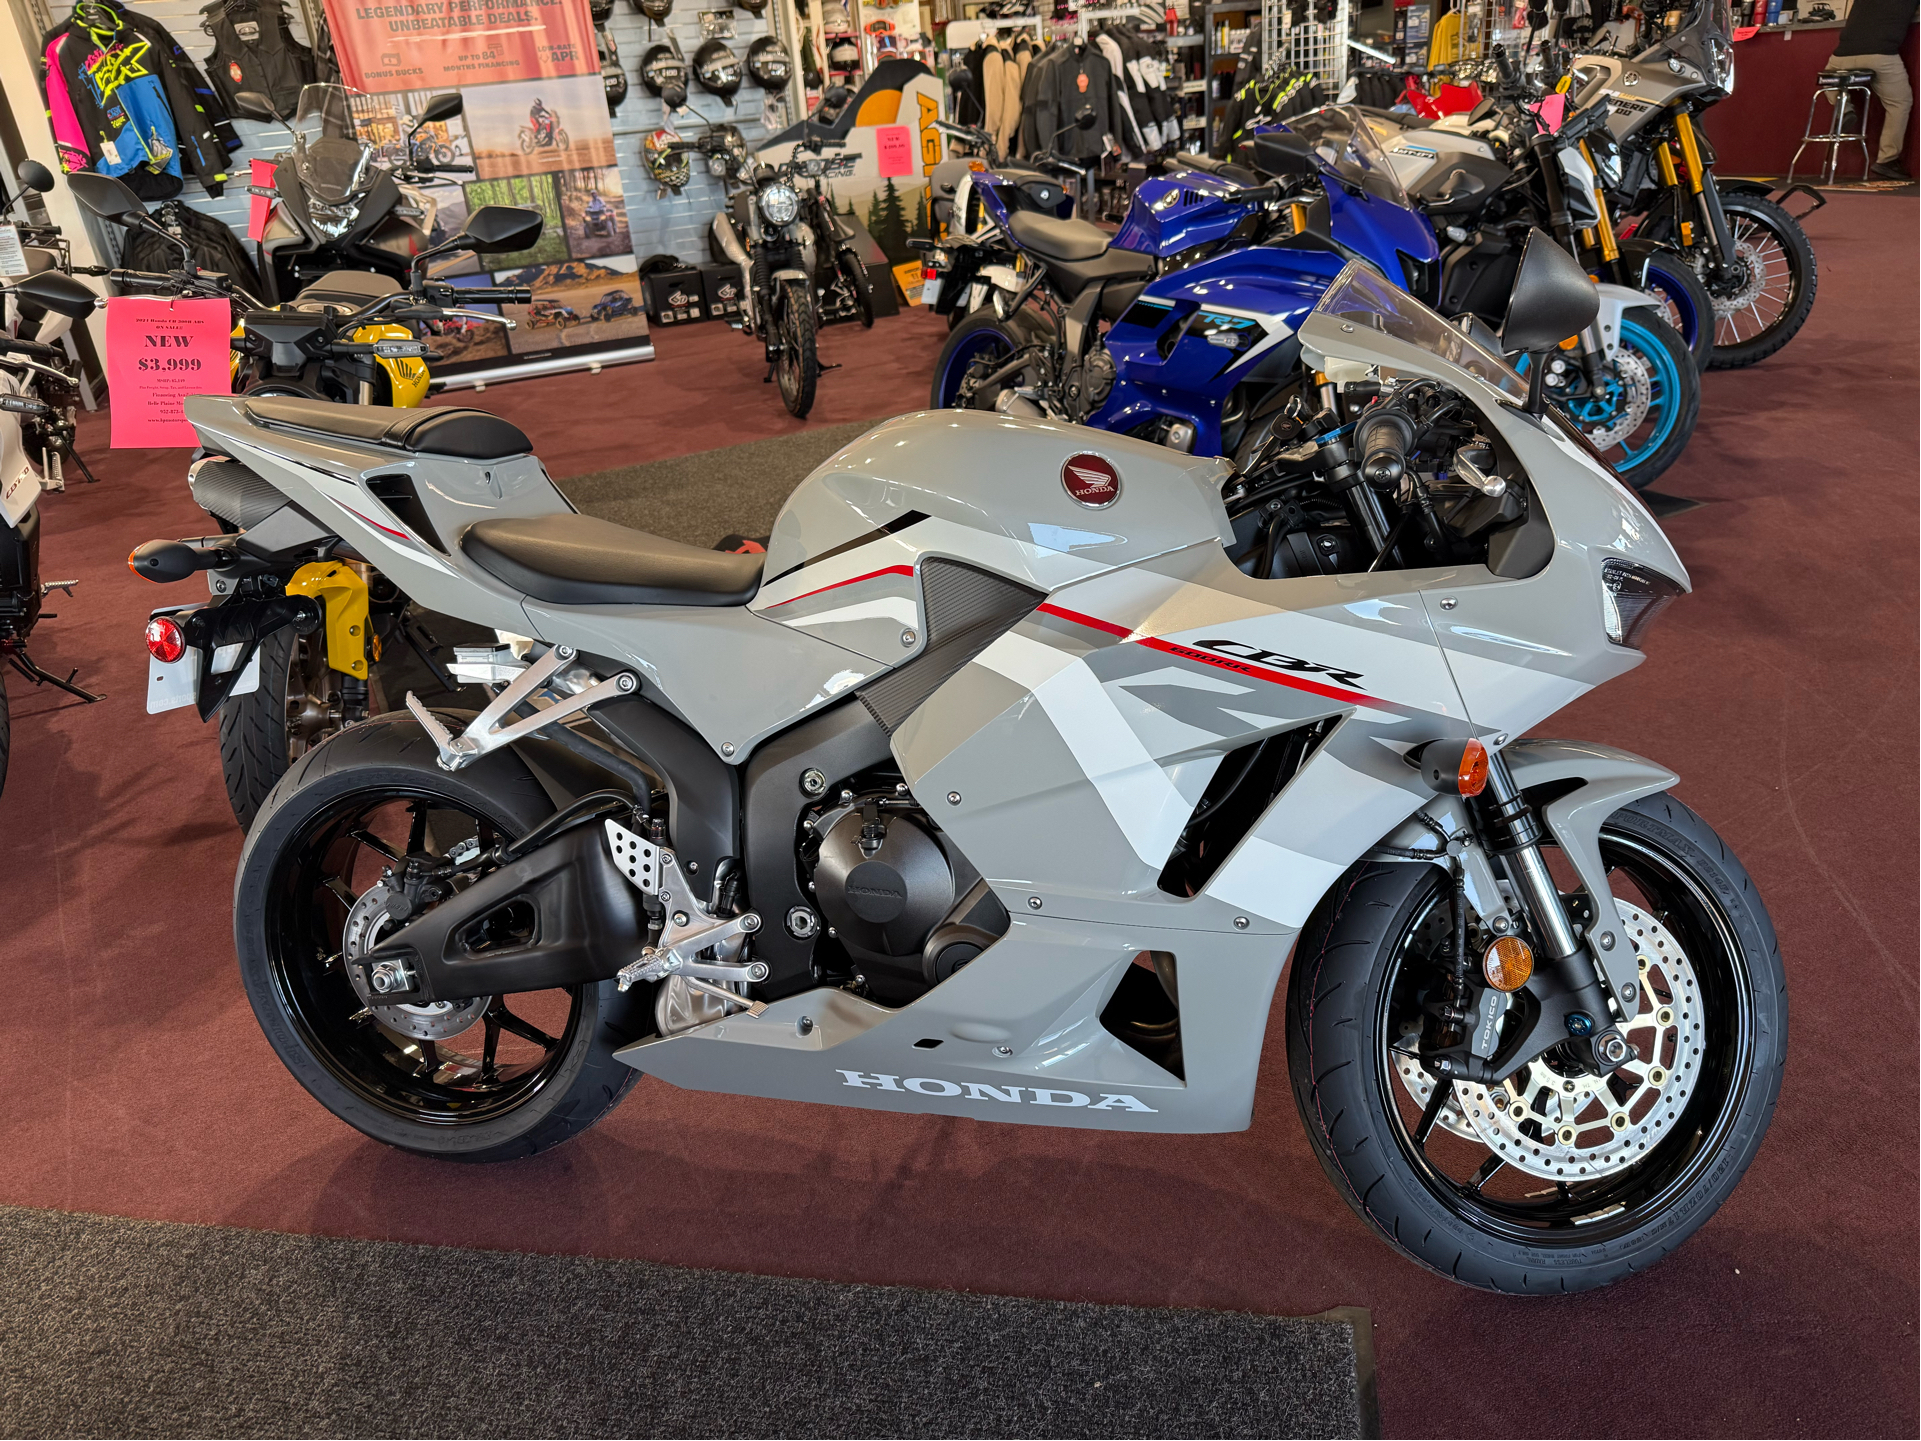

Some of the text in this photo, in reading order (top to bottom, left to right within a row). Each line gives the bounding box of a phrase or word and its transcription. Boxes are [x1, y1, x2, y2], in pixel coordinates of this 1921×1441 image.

[355, 0, 562, 20] LEGENDARY PERFORMANCE.
[388, 10, 539, 32] UNBEATABLE DEALS.
[537, 43, 577, 53] LOW-RATE
[458, 50, 496, 62] UP TO 84
[550, 50, 579, 63] APR
[364, 67, 424, 79] BONUS BUCKS
[443, 60, 520, 72] MONTHS FINANCING
[144, 335, 194, 348] NEW
[138, 357, 202, 372] $3,999
[1075, 486, 1115, 496] HONDA
[1168, 646, 1252, 673] 600RR
[1192, 639, 1368, 692] CBR
[1612, 811, 1696, 858] PORTMAX
[847, 885, 903, 899] HONDA
[1481, 995, 1497, 1050] TOKICO
[835, 1069, 1159, 1113] HONDA
